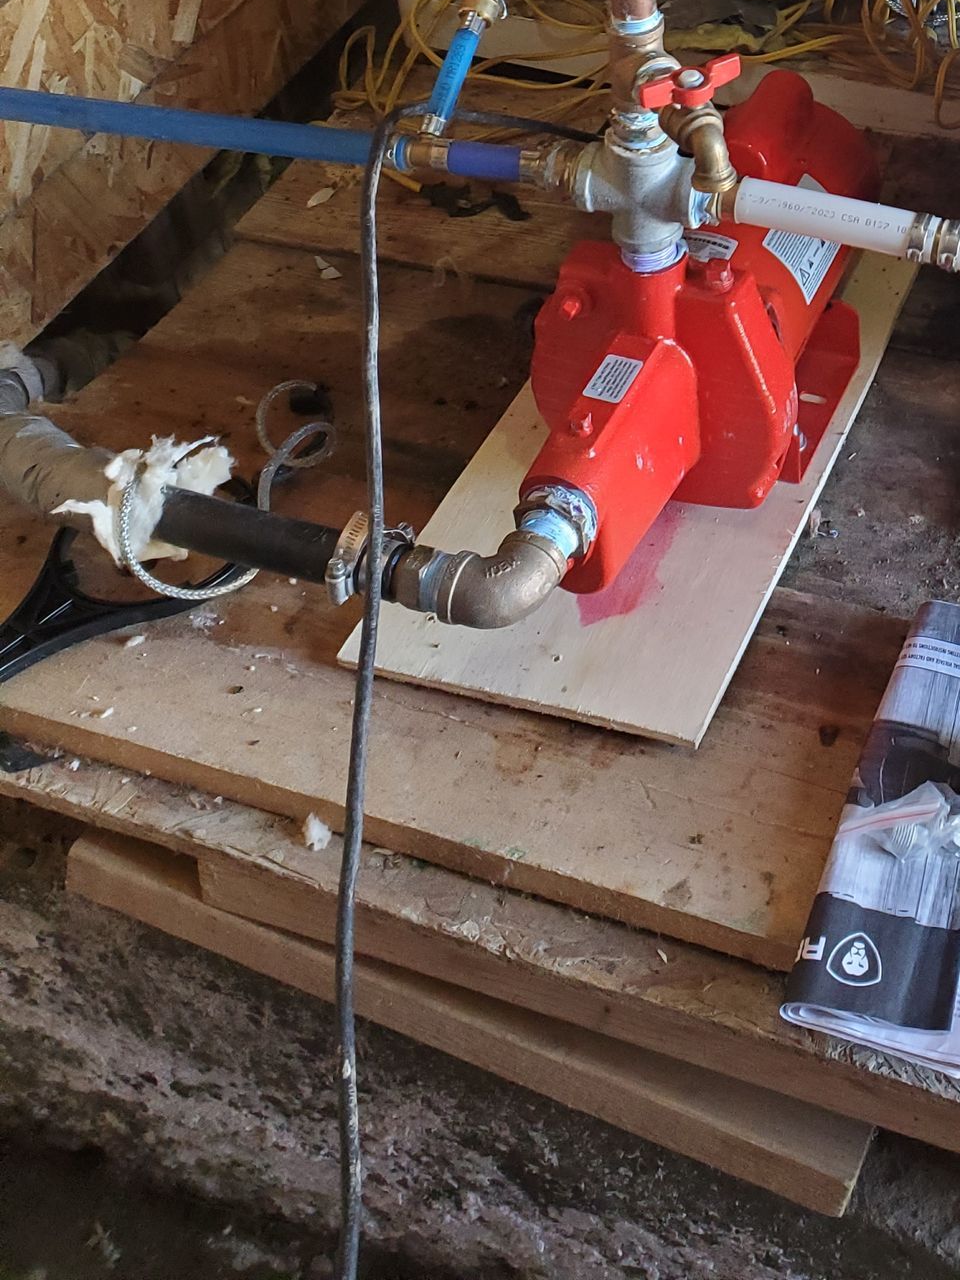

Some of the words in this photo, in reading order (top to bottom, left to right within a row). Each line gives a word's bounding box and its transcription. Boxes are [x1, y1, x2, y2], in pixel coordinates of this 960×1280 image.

[841, 213, 860, 225] CSA
[919, 643, 946, 654] INSTRUCTIONS
[908, 653, 925, 661] FACTORY
[935, 658, 952, 668] VOLTAGE
[794, 936, 826, 963] R
